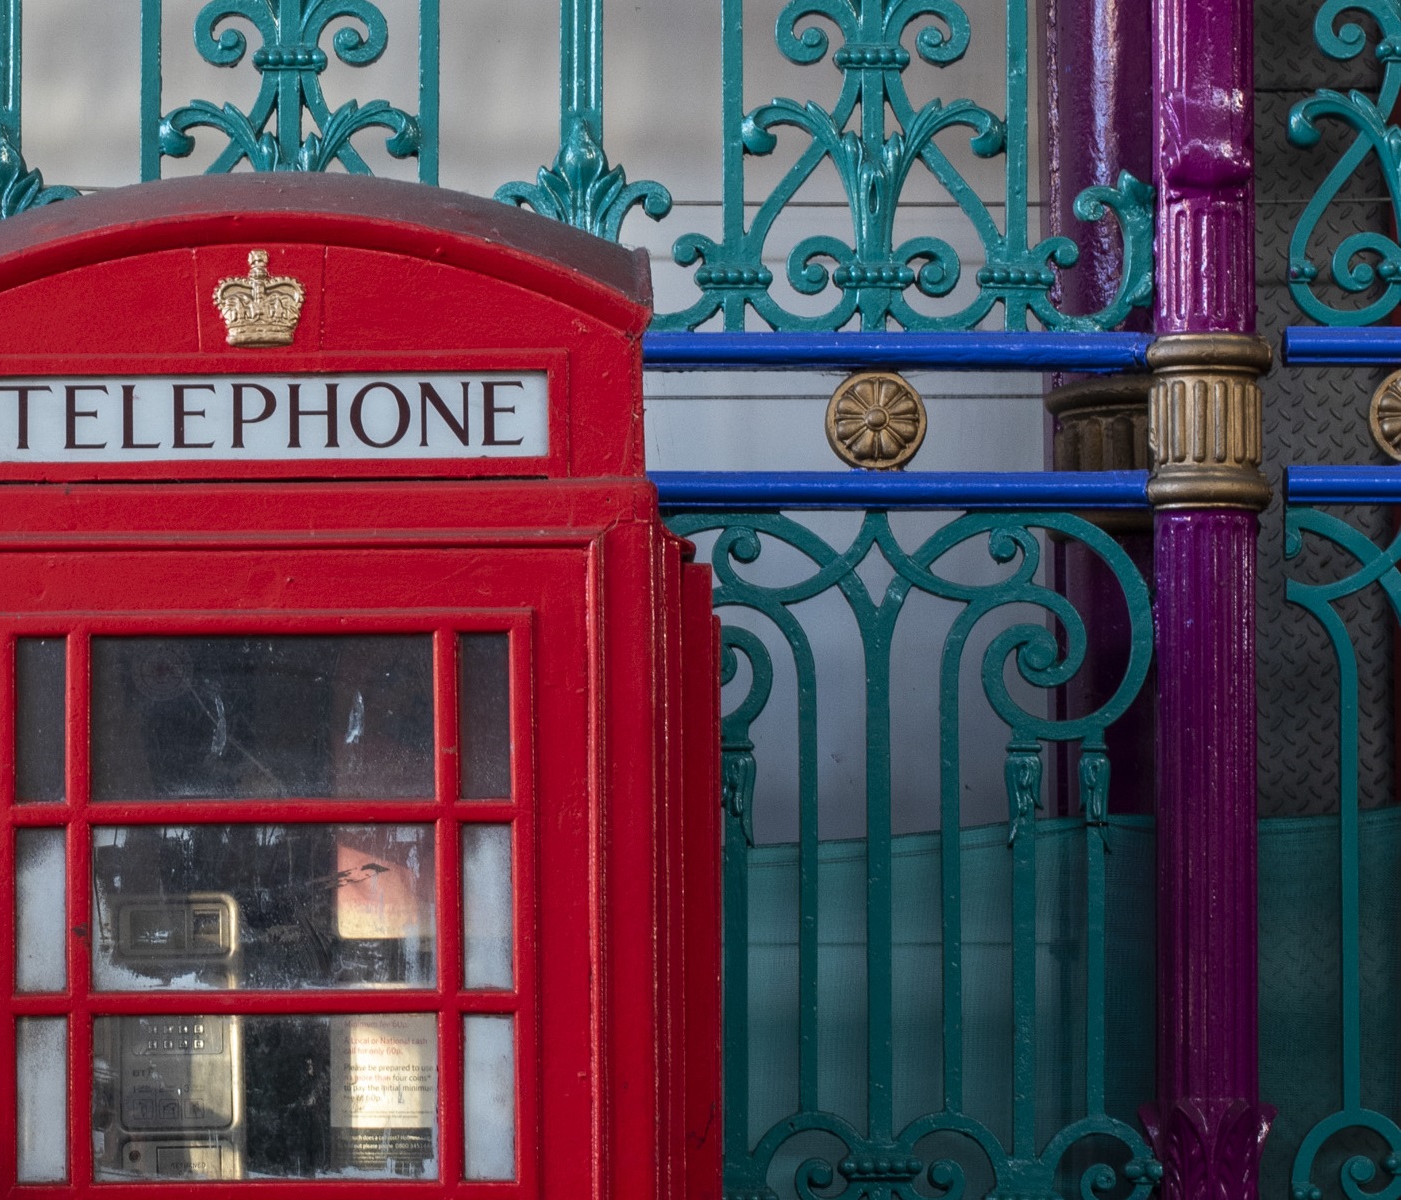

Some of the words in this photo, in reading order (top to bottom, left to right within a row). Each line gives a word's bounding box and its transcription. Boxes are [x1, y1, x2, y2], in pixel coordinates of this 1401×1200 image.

[380, 1036, 410, 1045] National
[411, 1036, 428, 1045] cash
[379, 1063, 410, 1073] prepared
[392, 1073, 407, 1081] four
[367, 1083, 379, 1092] the
